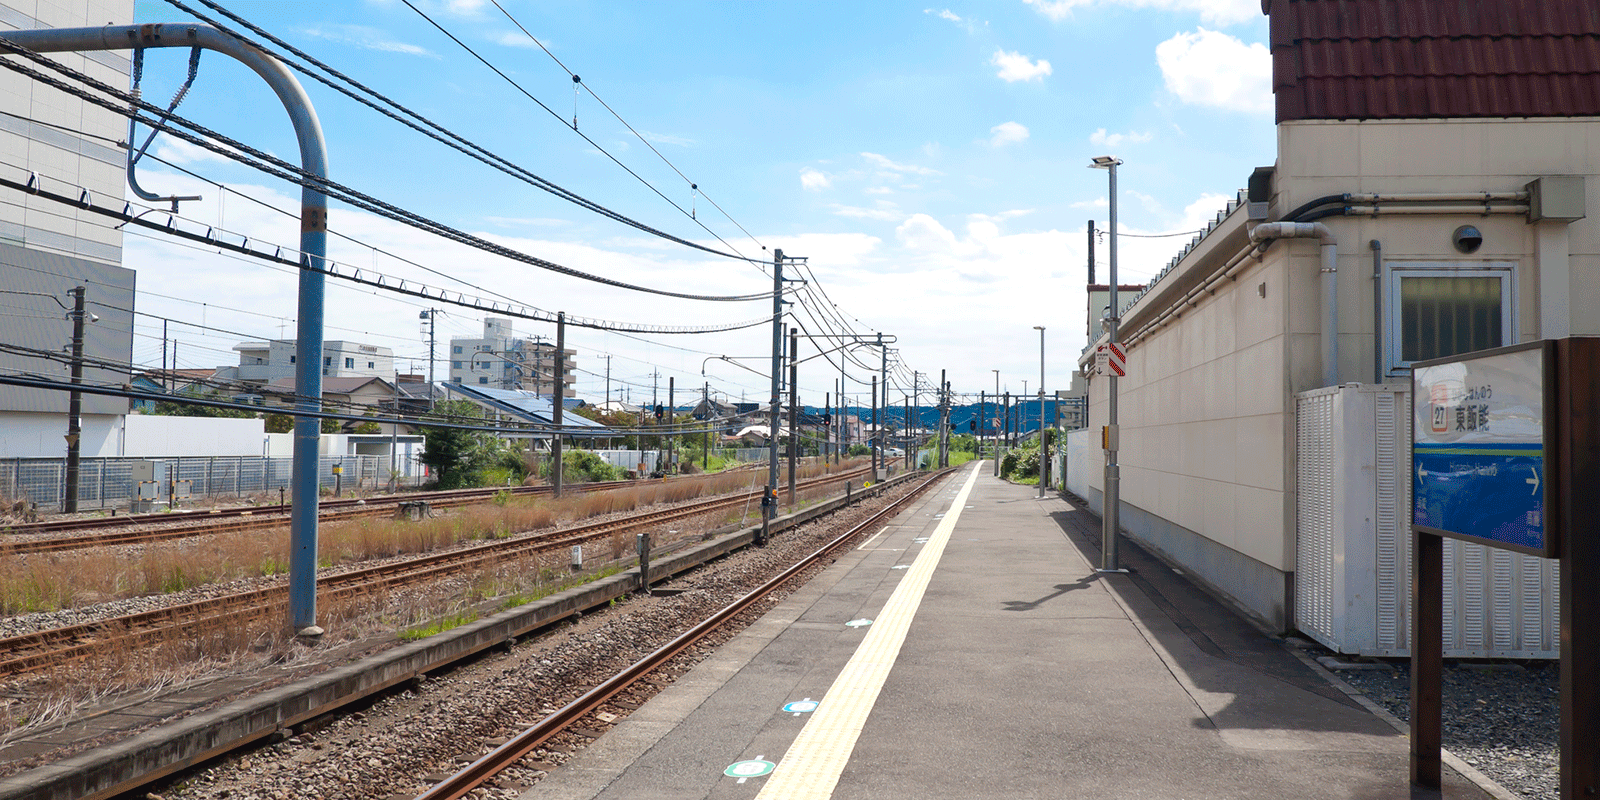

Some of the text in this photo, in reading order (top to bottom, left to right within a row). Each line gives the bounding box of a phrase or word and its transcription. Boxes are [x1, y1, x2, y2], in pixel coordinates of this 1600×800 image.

[1434, 406, 1445, 425] 27
[1455, 403, 1490, 432] 東飯能
